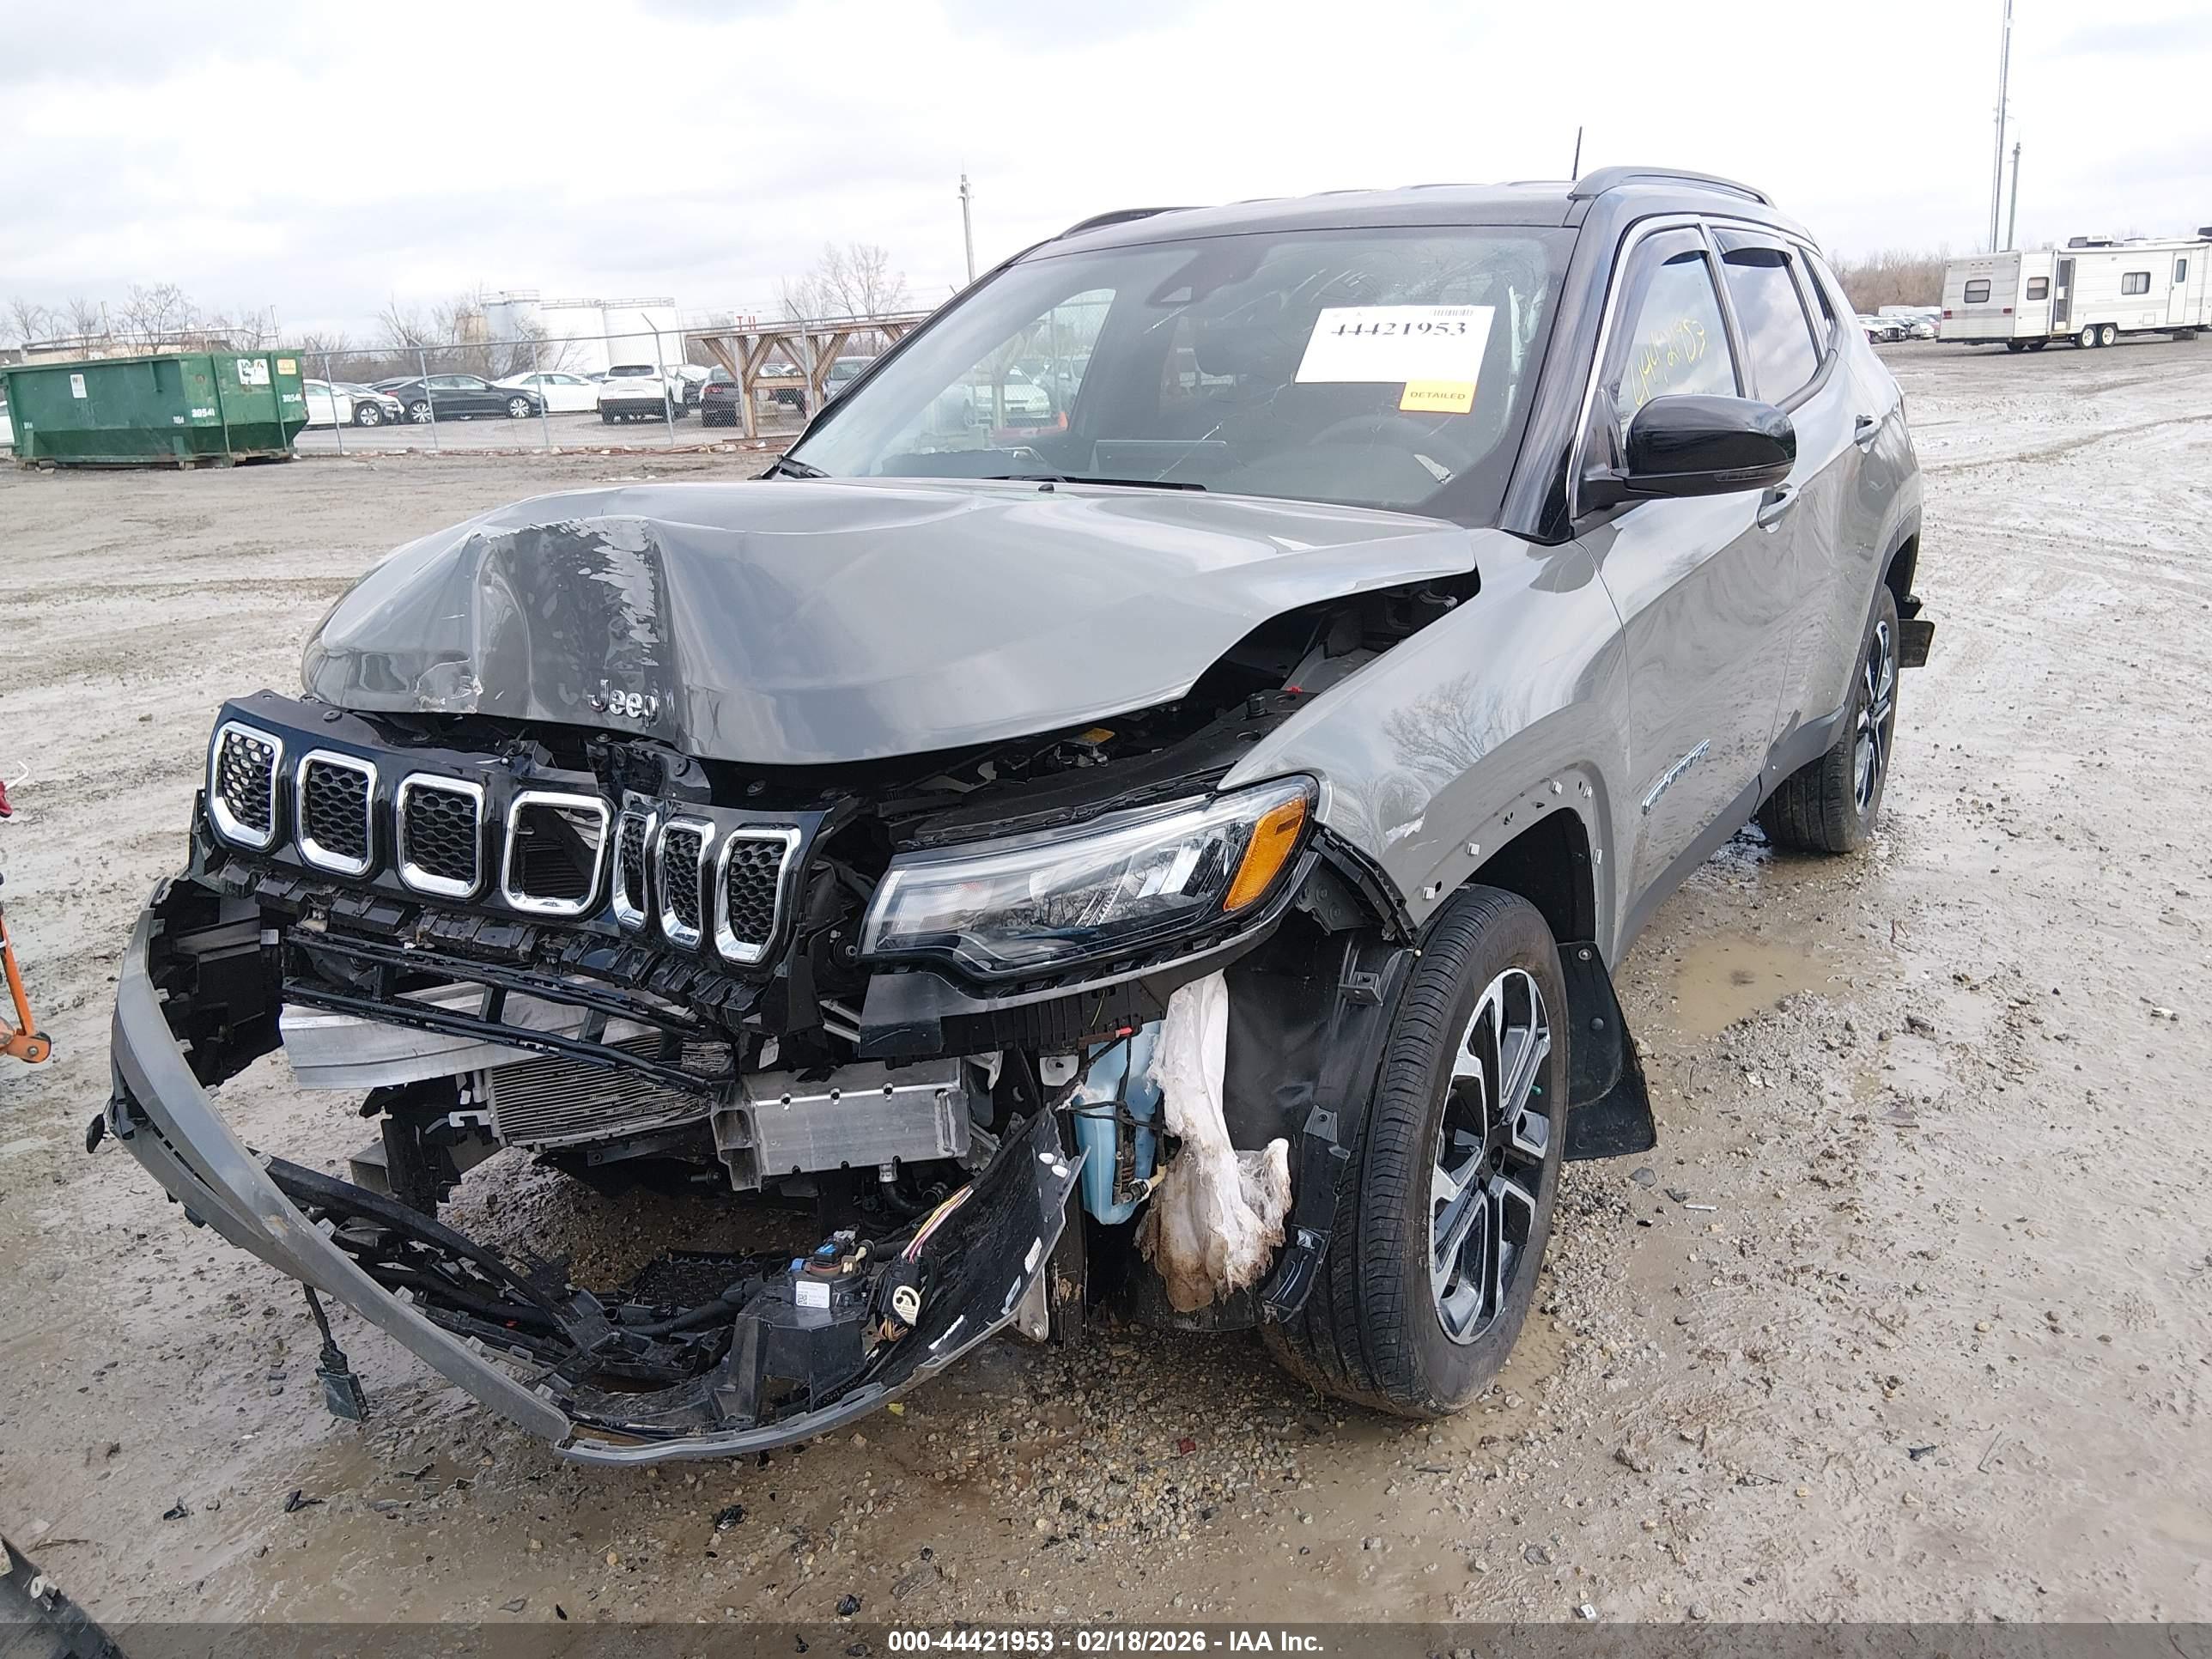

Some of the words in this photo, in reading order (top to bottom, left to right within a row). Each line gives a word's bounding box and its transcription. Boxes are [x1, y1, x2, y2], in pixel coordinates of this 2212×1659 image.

[1330, 322, 1467, 337] 44421953
[1410, 391, 1466, 401] DETAILED
[586, 678, 660, 727] Jeep
